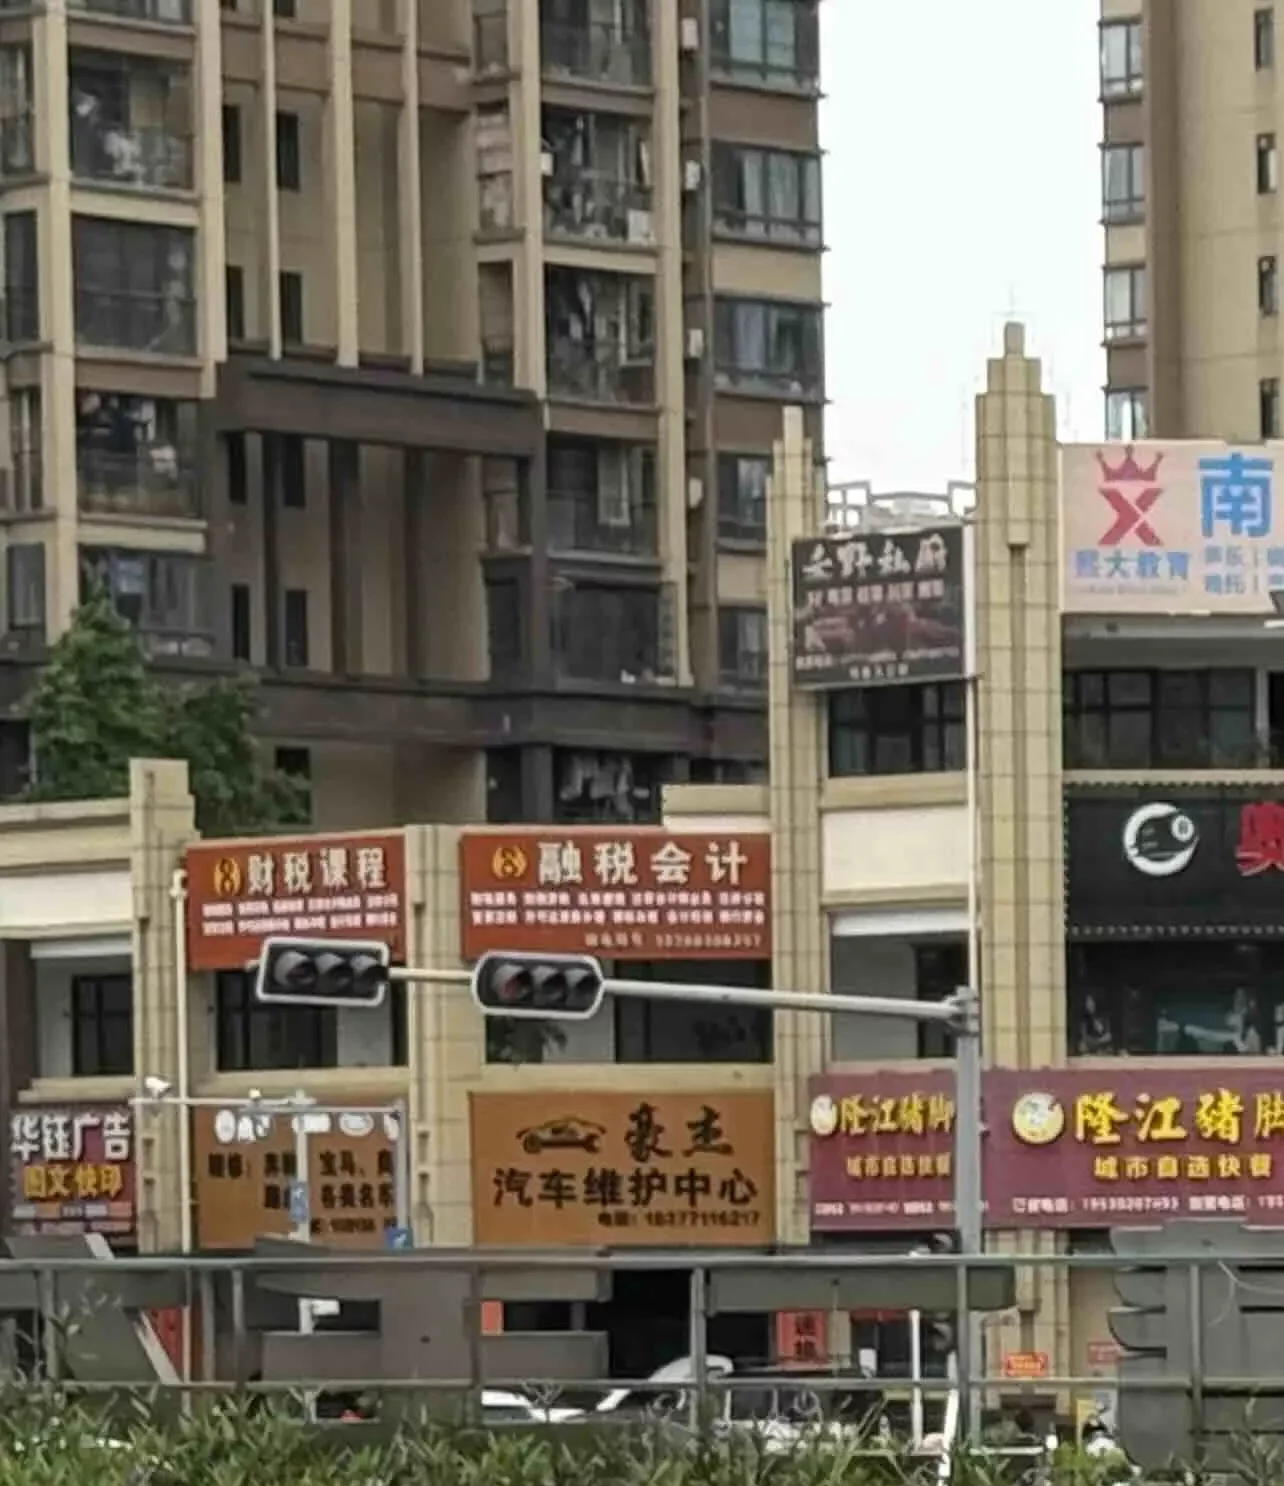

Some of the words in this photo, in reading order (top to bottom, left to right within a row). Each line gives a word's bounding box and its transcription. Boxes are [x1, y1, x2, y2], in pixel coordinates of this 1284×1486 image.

[248, 847, 387, 896] 财税课程
[537, 840, 749, 886] 融税会计
[839, 1091, 988, 1135] 隆江猪脚
[493, 1167, 760, 1209] 汽车维护中心
[1094, 1154, 1273, 1180] 城市自选快餐
